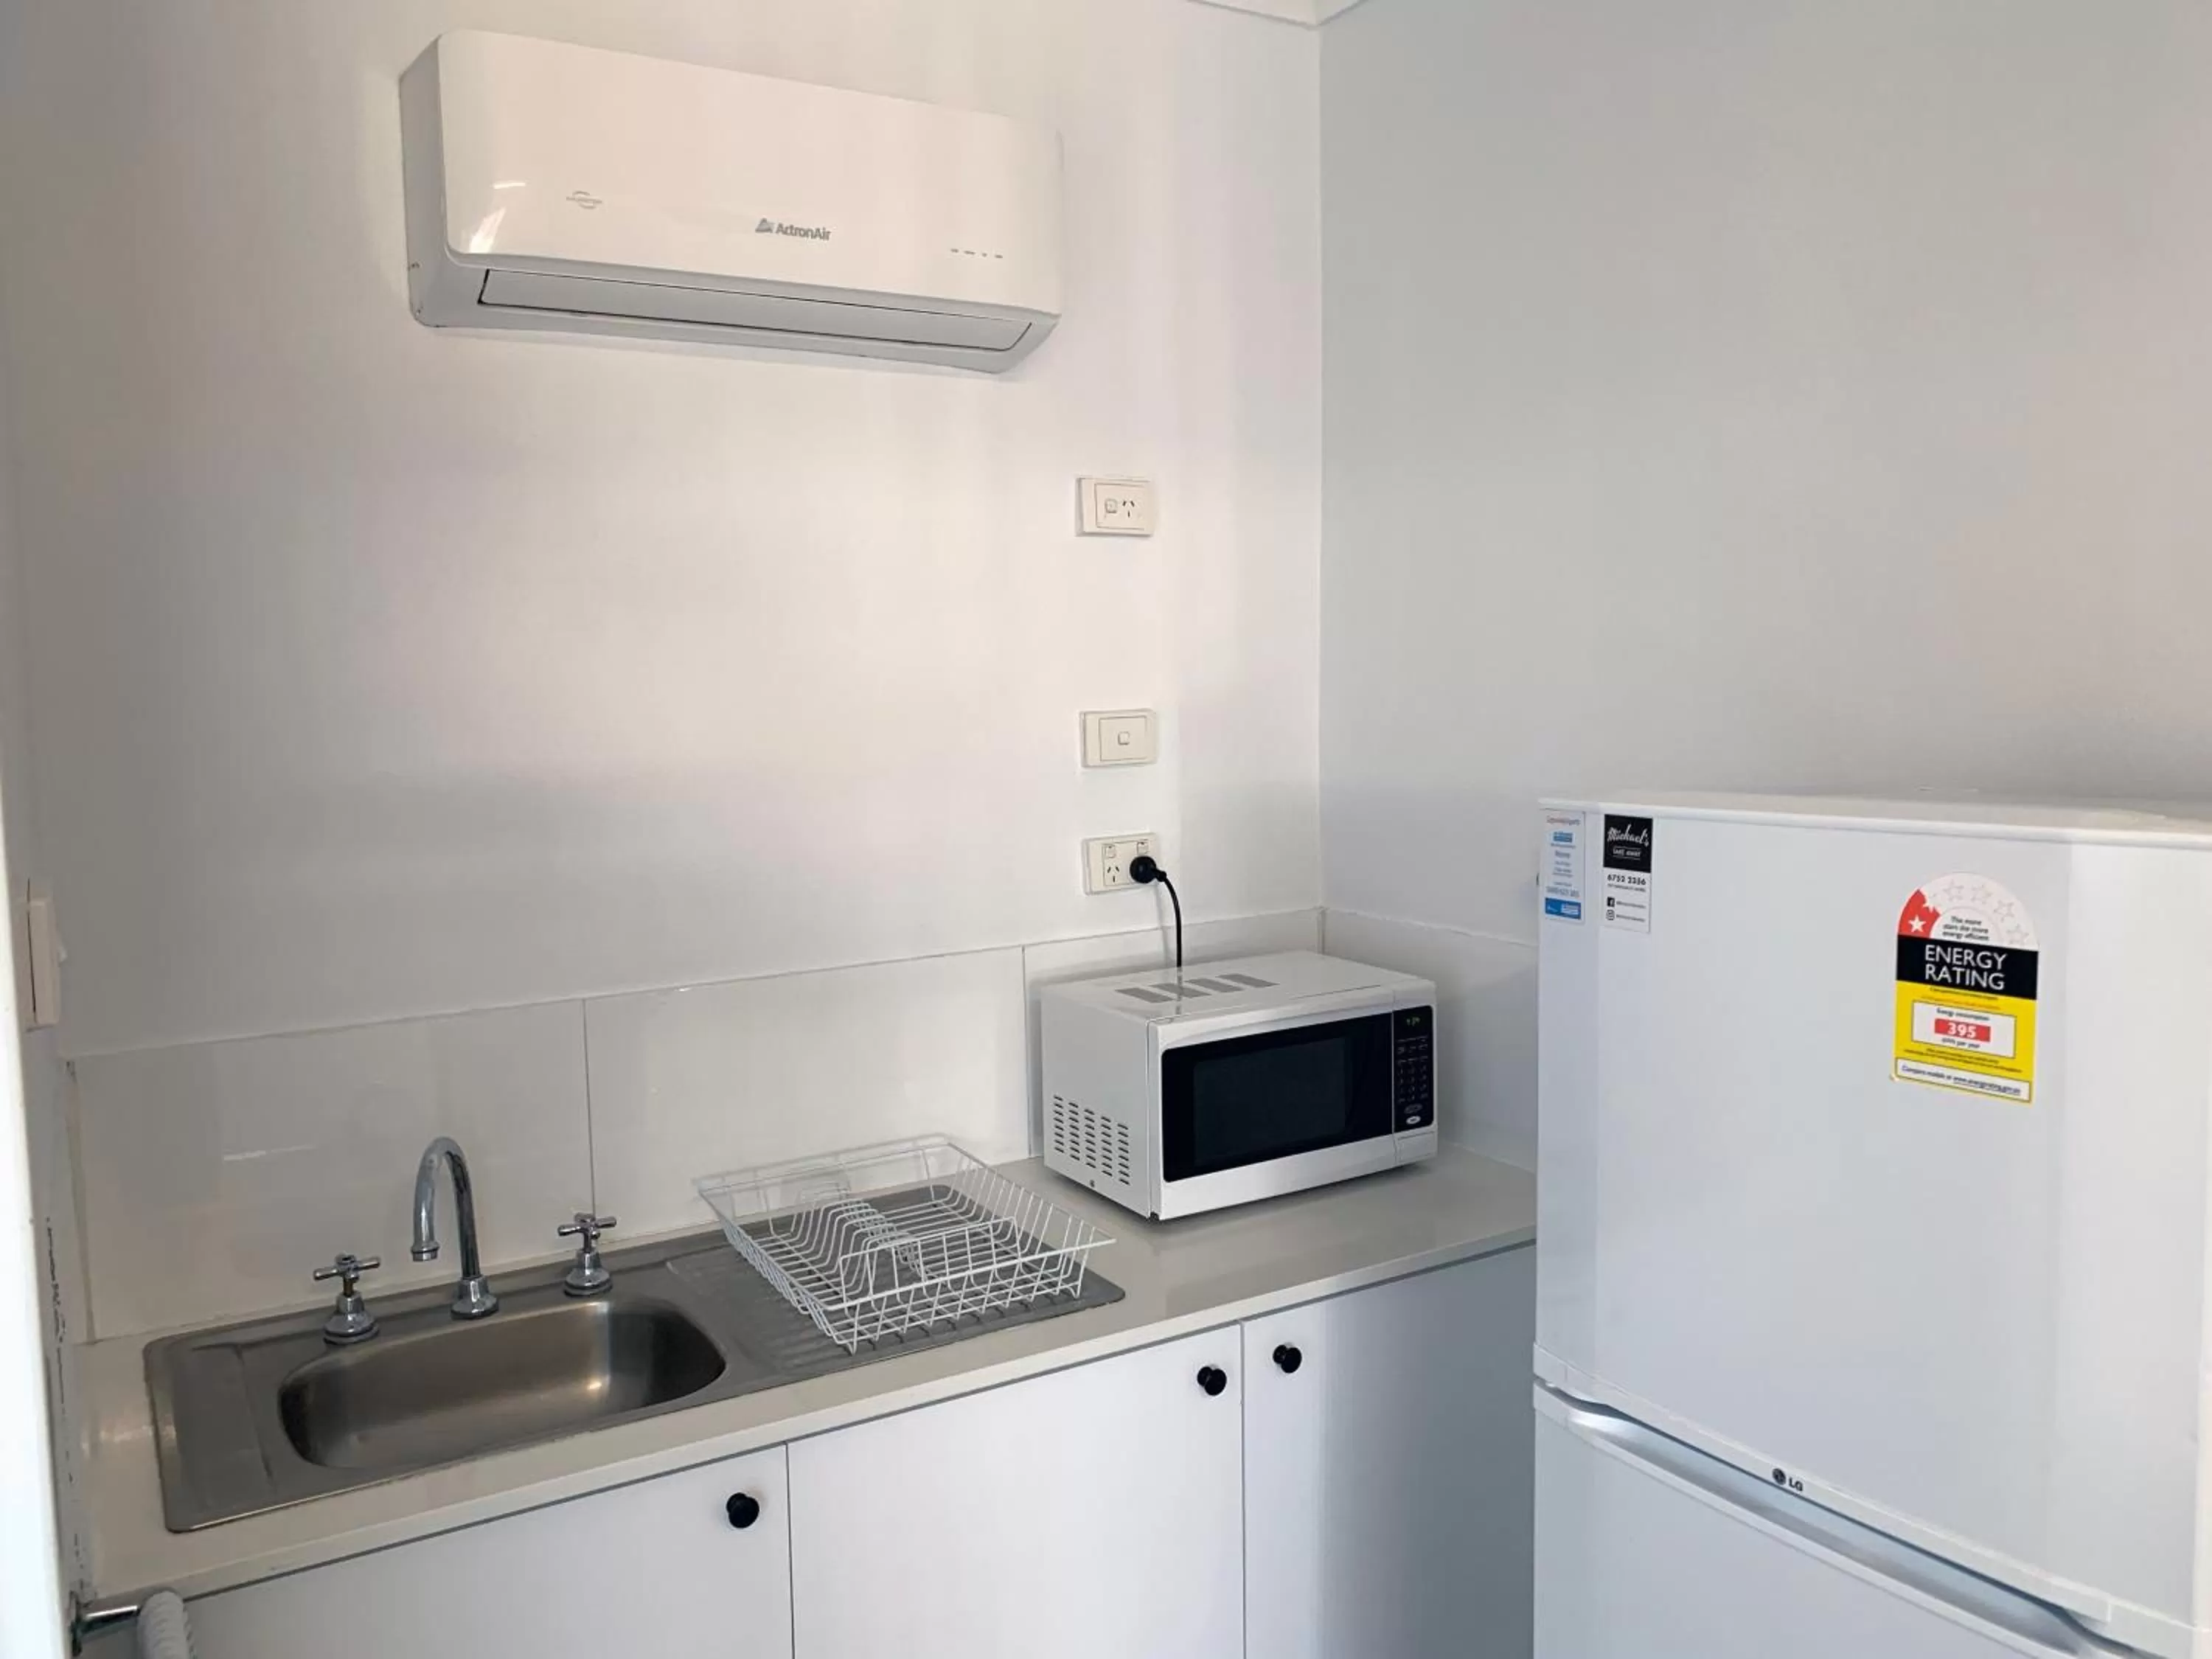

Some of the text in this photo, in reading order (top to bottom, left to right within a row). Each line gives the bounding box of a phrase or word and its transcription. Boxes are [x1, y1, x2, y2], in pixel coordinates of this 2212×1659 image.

[776, 222, 832, 241] ActronAir
[1607, 824, 1649, 847] Michael's
[1607, 874, 1626, 883] 6752
[1942, 931, 1963, 939] energy
[1925, 945, 2008, 970] ENERGY
[1925, 963, 2005, 990] RATING
[1947, 1022, 1977, 1038] 395
[1789, 1477, 1804, 1492] LG
